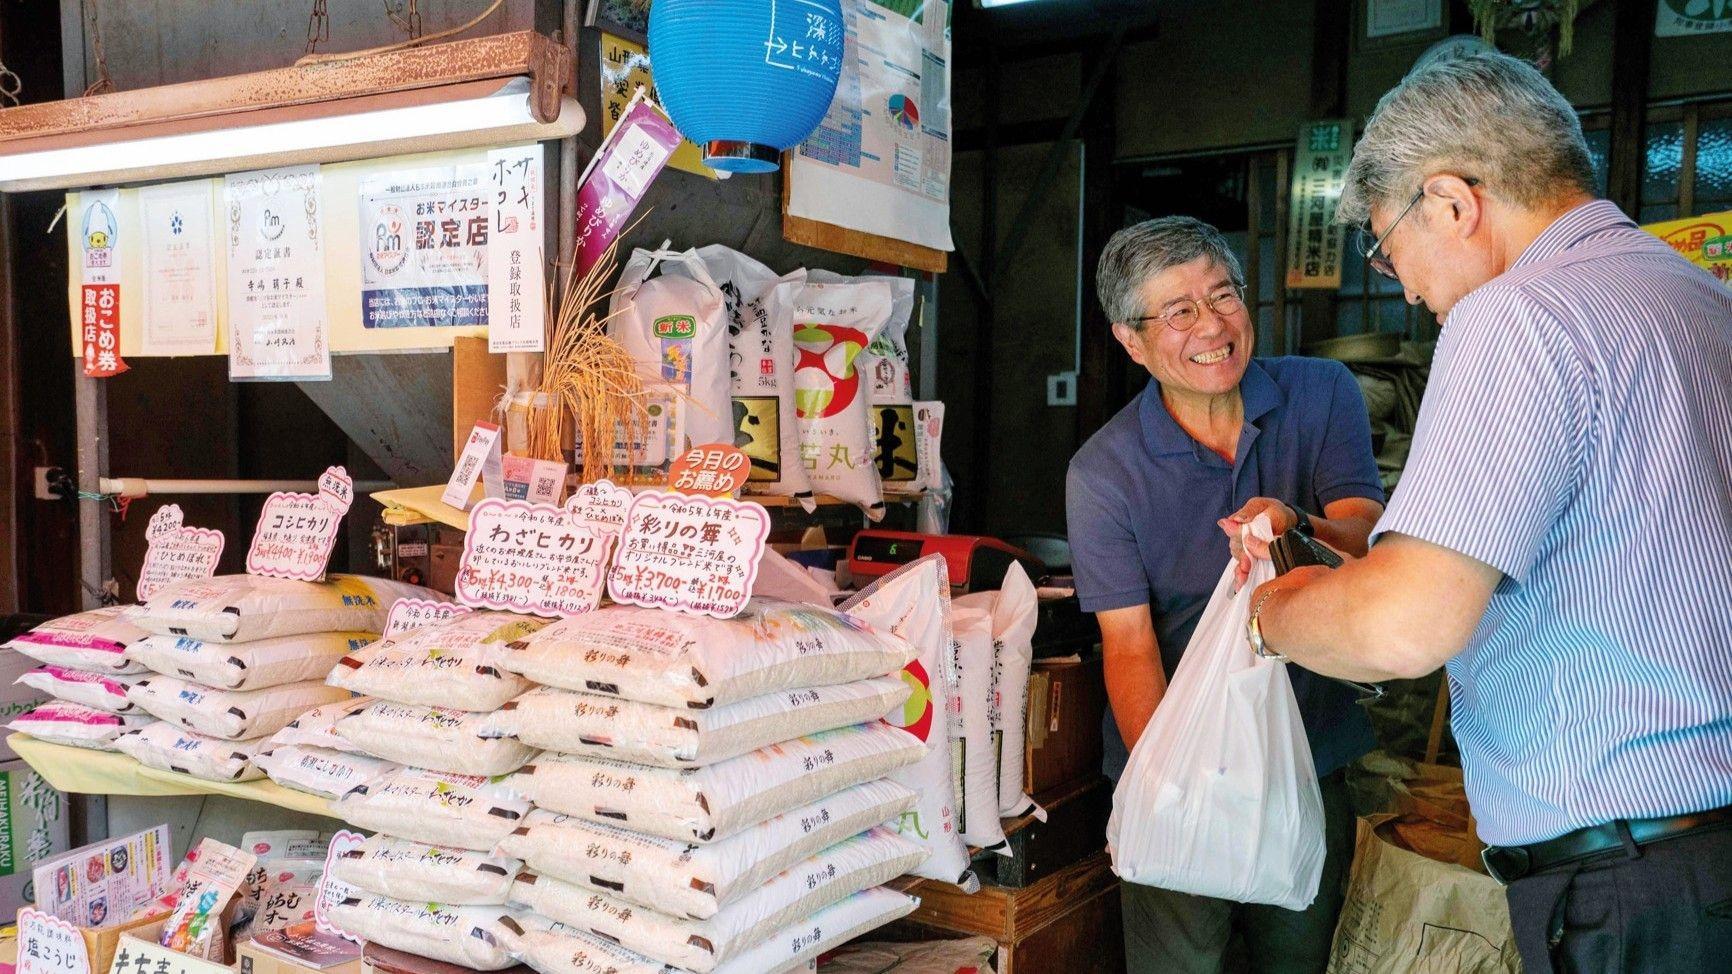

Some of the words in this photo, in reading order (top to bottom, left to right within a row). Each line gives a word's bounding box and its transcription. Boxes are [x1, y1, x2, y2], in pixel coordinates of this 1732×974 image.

[416, 198, 488, 215] お米マイスター
[416, 216, 488, 250] 認定店
[509, 250, 521, 329] 登録取扱店
[85, 288, 97, 343] 取扱店
[99, 288, 117, 371] おこめ券
[658, 321, 692, 333] 新米
[758, 376, 777, 388] 5kg
[686, 449, 744, 470] 今月の
[323, 476, 348, 500] 無洗米
[674, 469, 735, 492] お薦め
[589, 496, 623, 508] コシヒカリ
[272, 514, 329, 534] コシヒカリ
[586, 512, 624, 523] ひとめぼれ
[489, 524, 594, 555] わざヒカリ
[639, 513, 722, 547] 彩りの舞
[160, 551, 205, 564] ひとめぼれ
[695, 549, 737, 563] 三河屋の
[342, 594, 376, 606] 無洗米
[585, 650, 631, 669] 彩りの舞
[575, 702, 620, 721] 彩りの舞
[592, 772, 636, 794] 彩りの舞
[586, 843, 632, 866] 彩りの舞
[587, 895, 632, 924] 彩りの舞
[28, 937, 76, 969] 塩こうじ
